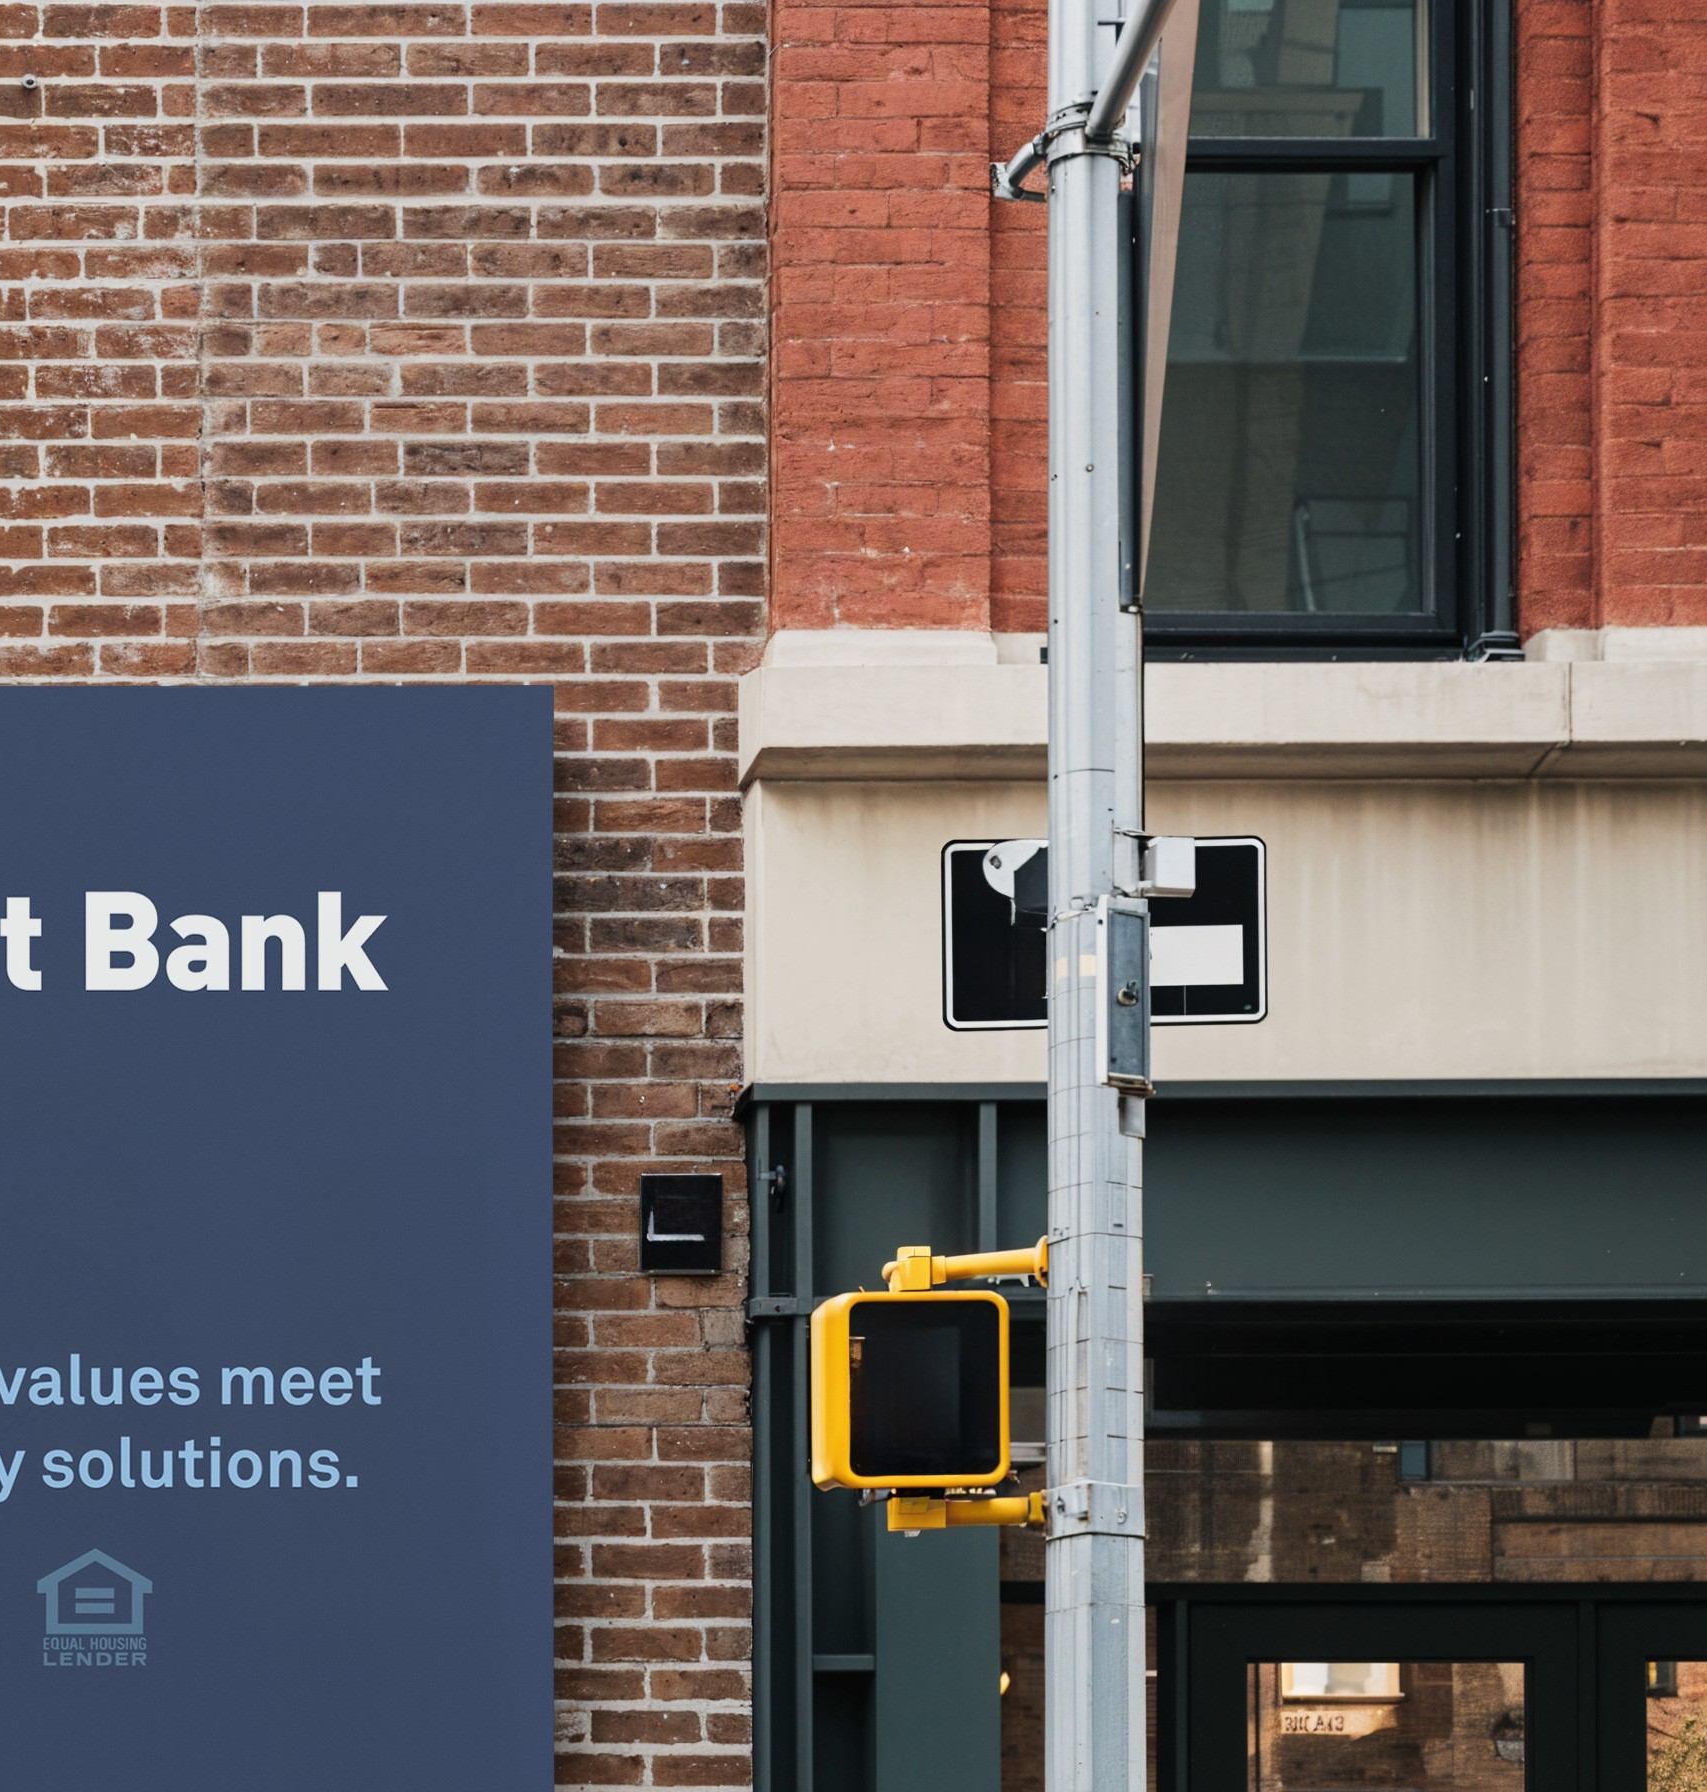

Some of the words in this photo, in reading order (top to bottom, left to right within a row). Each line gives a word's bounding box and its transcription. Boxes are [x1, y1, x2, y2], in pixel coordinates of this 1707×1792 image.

[86, 891, 388, 991] Bank
[222, 1357, 381, 1405] meet
[42, 1436, 358, 1488] solutions.
[43, 1637, 85, 1651] EQUAL
[90, 1637, 147, 1651] HOUSING
[43, 1652, 147, 1667] LENDER
